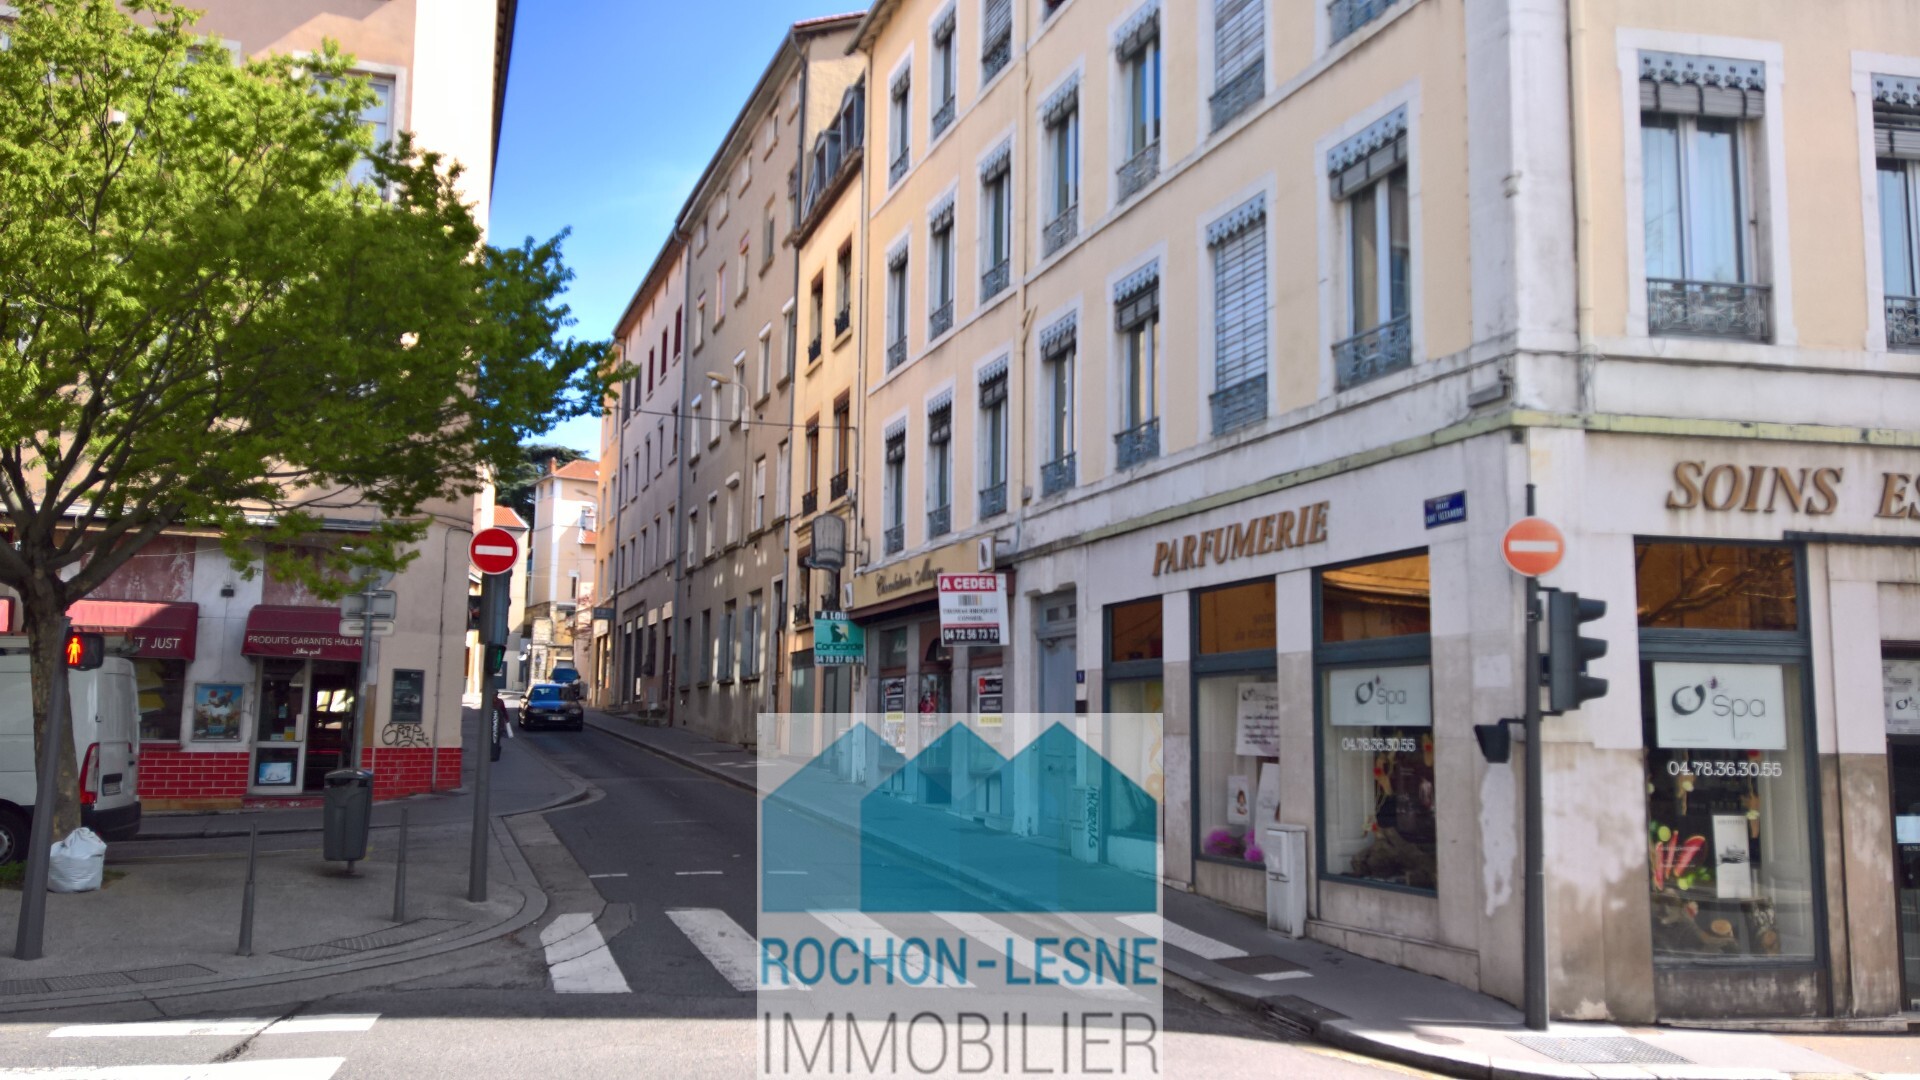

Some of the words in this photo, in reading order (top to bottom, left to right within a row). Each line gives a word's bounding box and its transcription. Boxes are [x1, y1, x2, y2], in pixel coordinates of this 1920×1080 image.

[1665, 460, 1844, 515] SOINS
[1152, 500, 1330, 577] PARFUMERIE
[942, 577, 951, 590] A
[953, 577, 995, 590] CEDER
[830, 611, 847, 620] LOU
[247, 635, 289, 645] PRODUITS
[291, 637, 333, 646] GARANTIS
[944, 629, 954, 640] 04
[955, 629, 965, 640] 72
[978, 629, 988, 640] 73
[989, 629, 999, 640] 73
[150, 636, 181, 649] JUST
[815, 642, 865, 651] Concorde
[1667, 761, 1783, 777] 04.78.36.30.55
